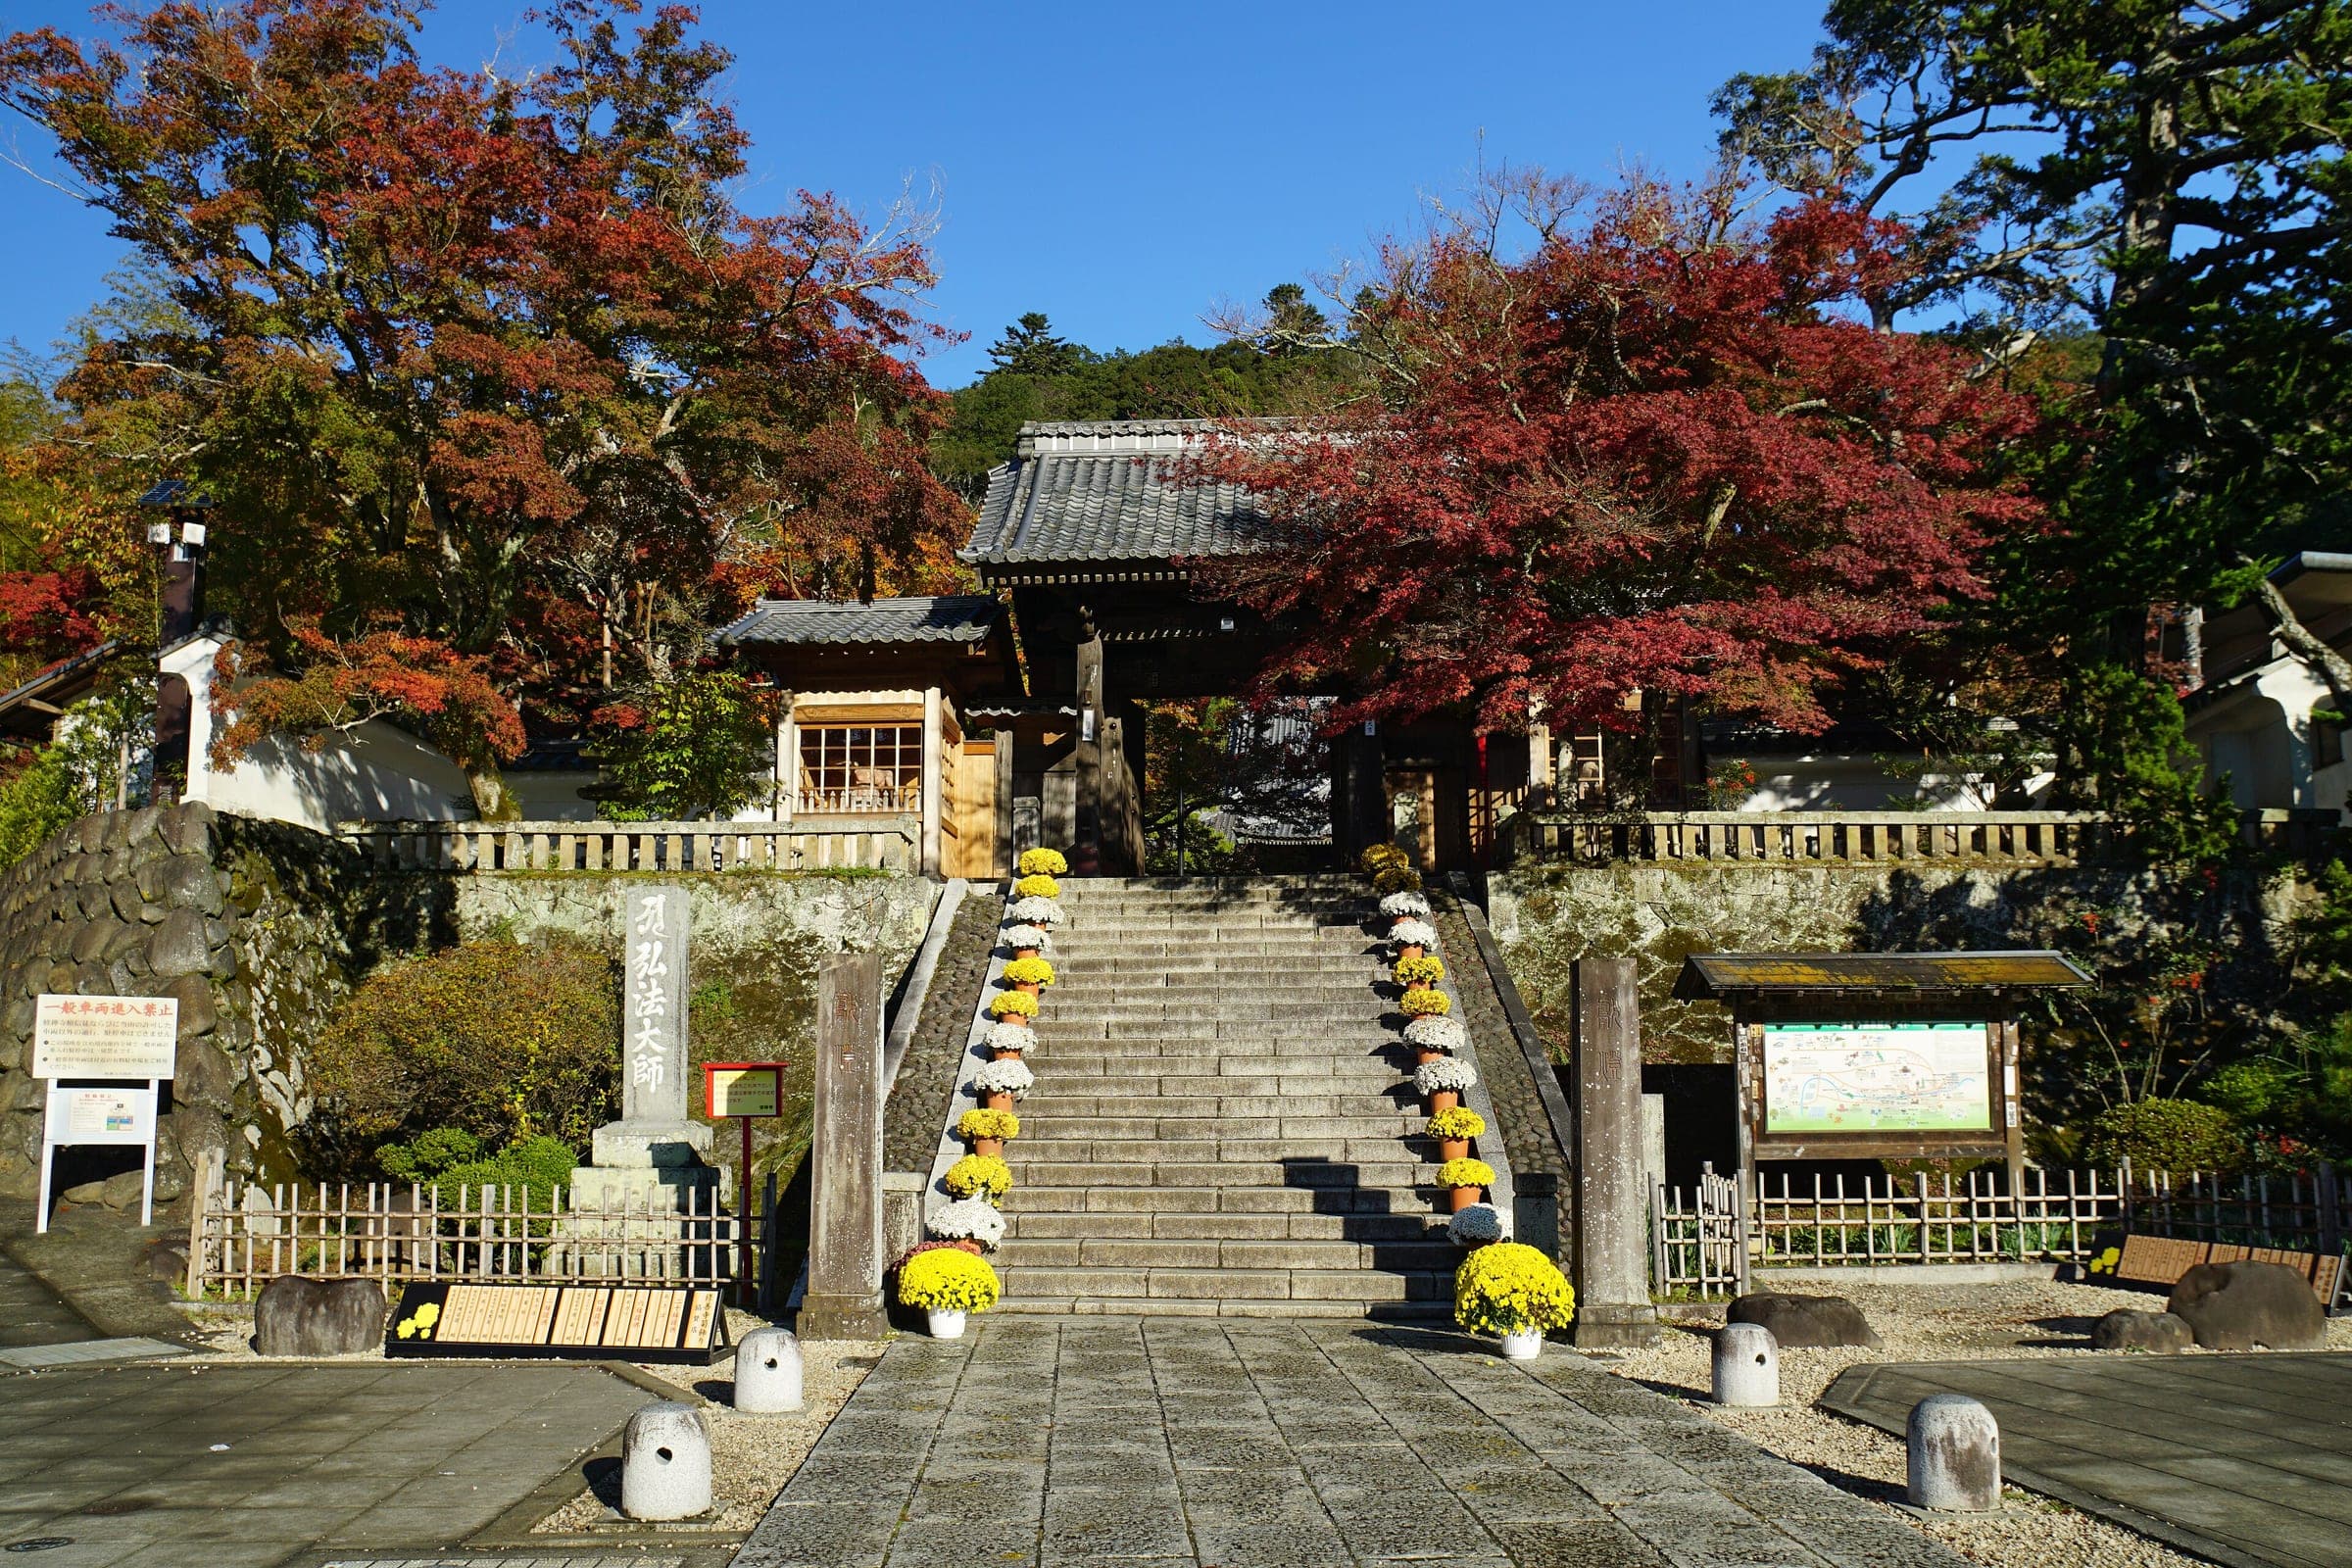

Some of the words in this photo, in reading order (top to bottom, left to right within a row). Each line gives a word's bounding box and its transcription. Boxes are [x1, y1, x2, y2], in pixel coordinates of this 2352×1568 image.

[44, 1001, 173, 1016] 一般車両進入禁止
